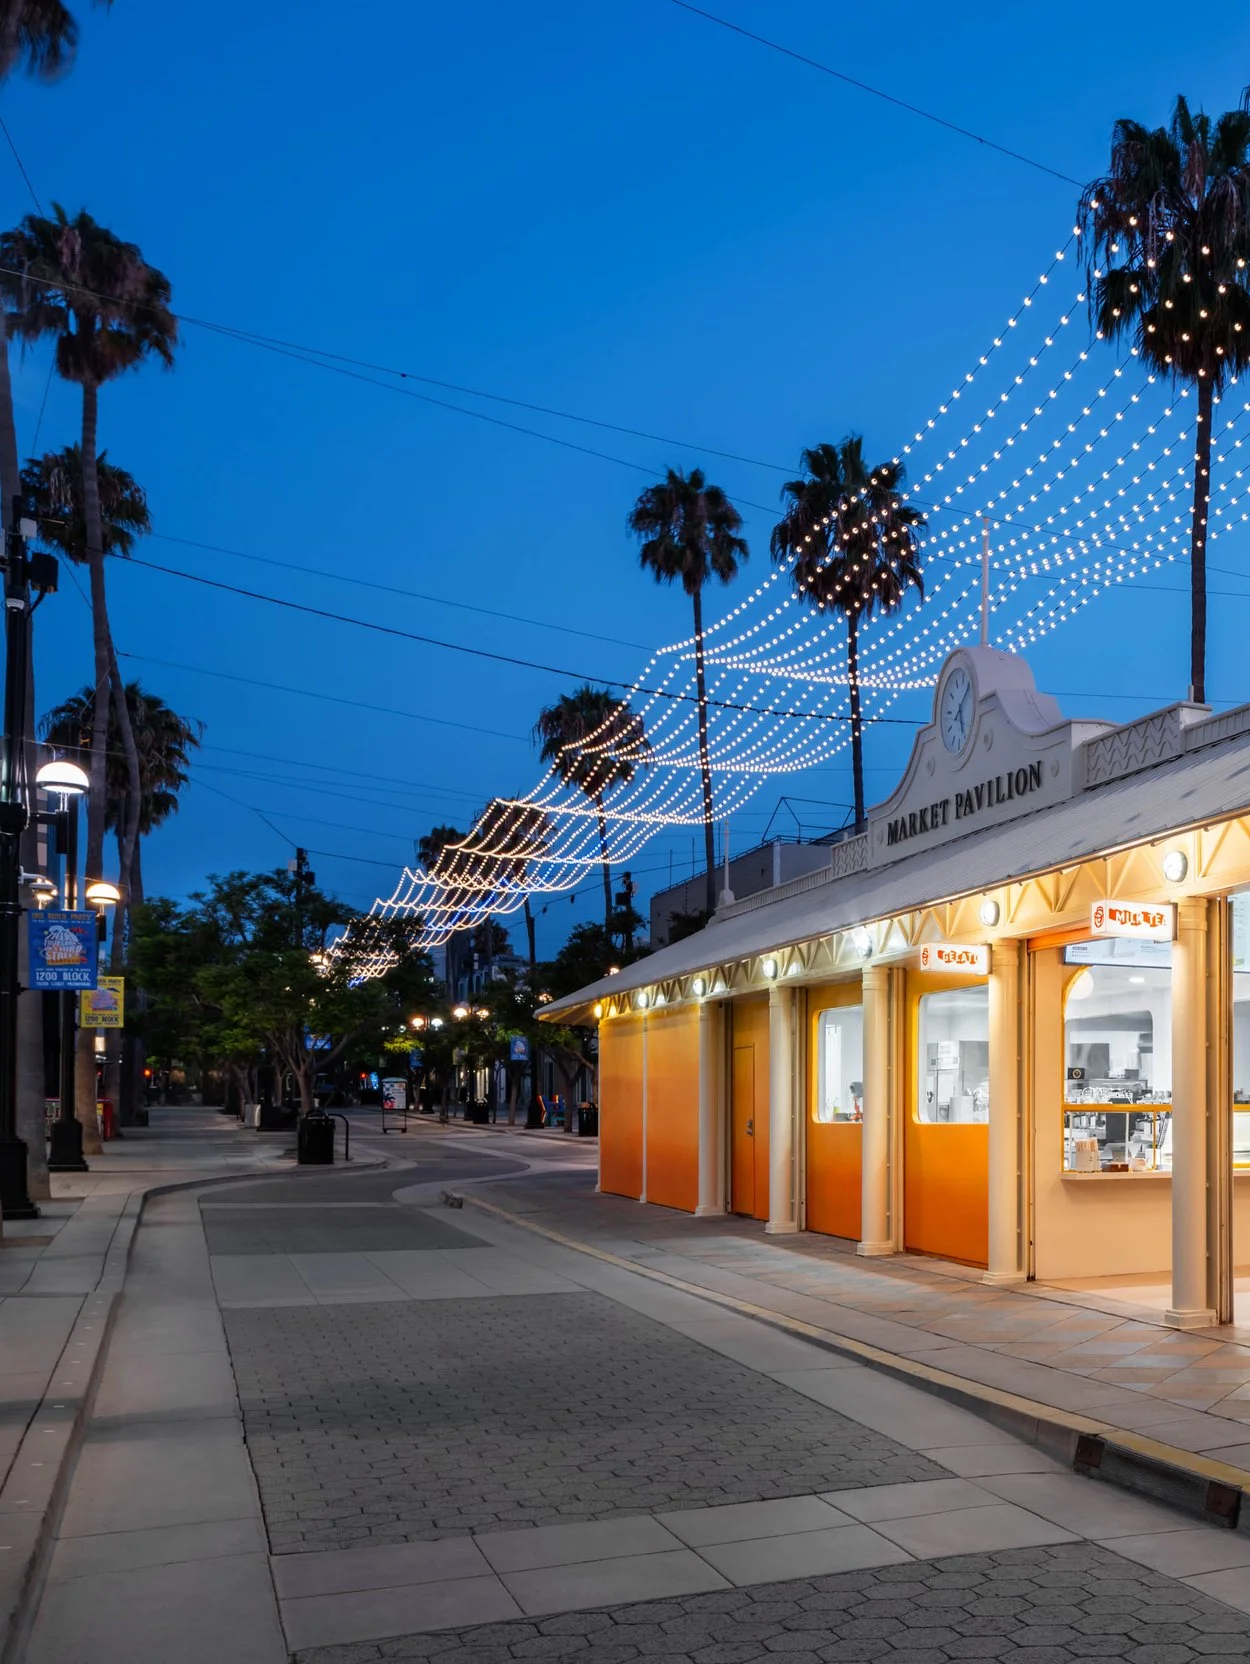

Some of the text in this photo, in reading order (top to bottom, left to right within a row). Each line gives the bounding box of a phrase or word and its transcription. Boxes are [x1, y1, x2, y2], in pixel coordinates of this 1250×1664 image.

[887, 760, 1042, 846] MARKET PAVILION
[1109, 908, 1143, 926] MILK
[937, 949, 978, 965] GELATO
[36, 971, 58, 981] 1200
